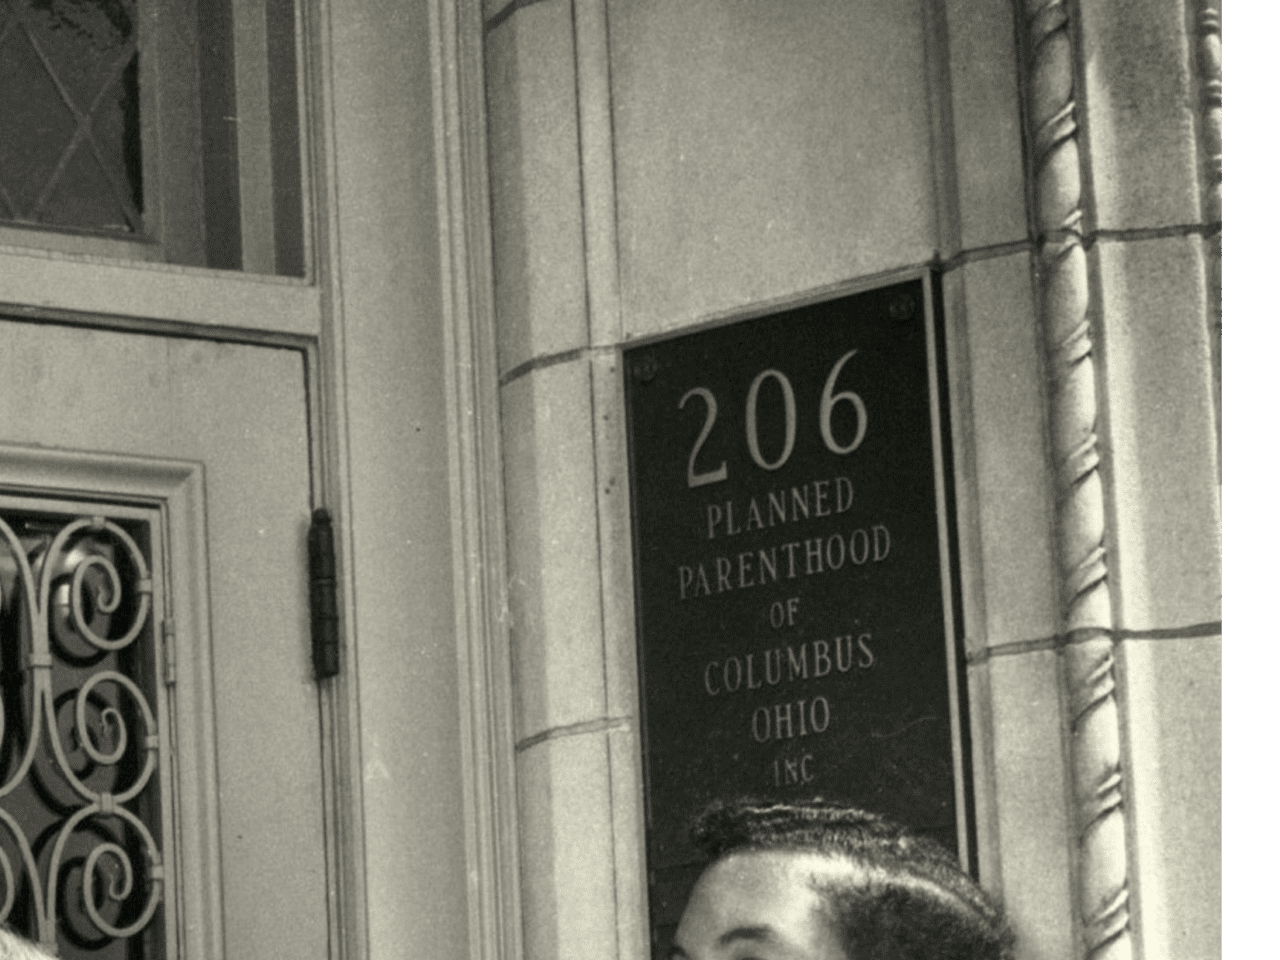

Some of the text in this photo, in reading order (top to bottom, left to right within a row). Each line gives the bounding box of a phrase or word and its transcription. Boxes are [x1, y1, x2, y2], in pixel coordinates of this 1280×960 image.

[677, 349, 867, 487] 206
[707, 476, 854, 539] PLANNED
[678, 524, 891, 600] PARENTHOOD
[769, 598, 800, 628] OF
[705, 633, 874, 696] COLUMBUS
[752, 696, 831, 743] OHIO
